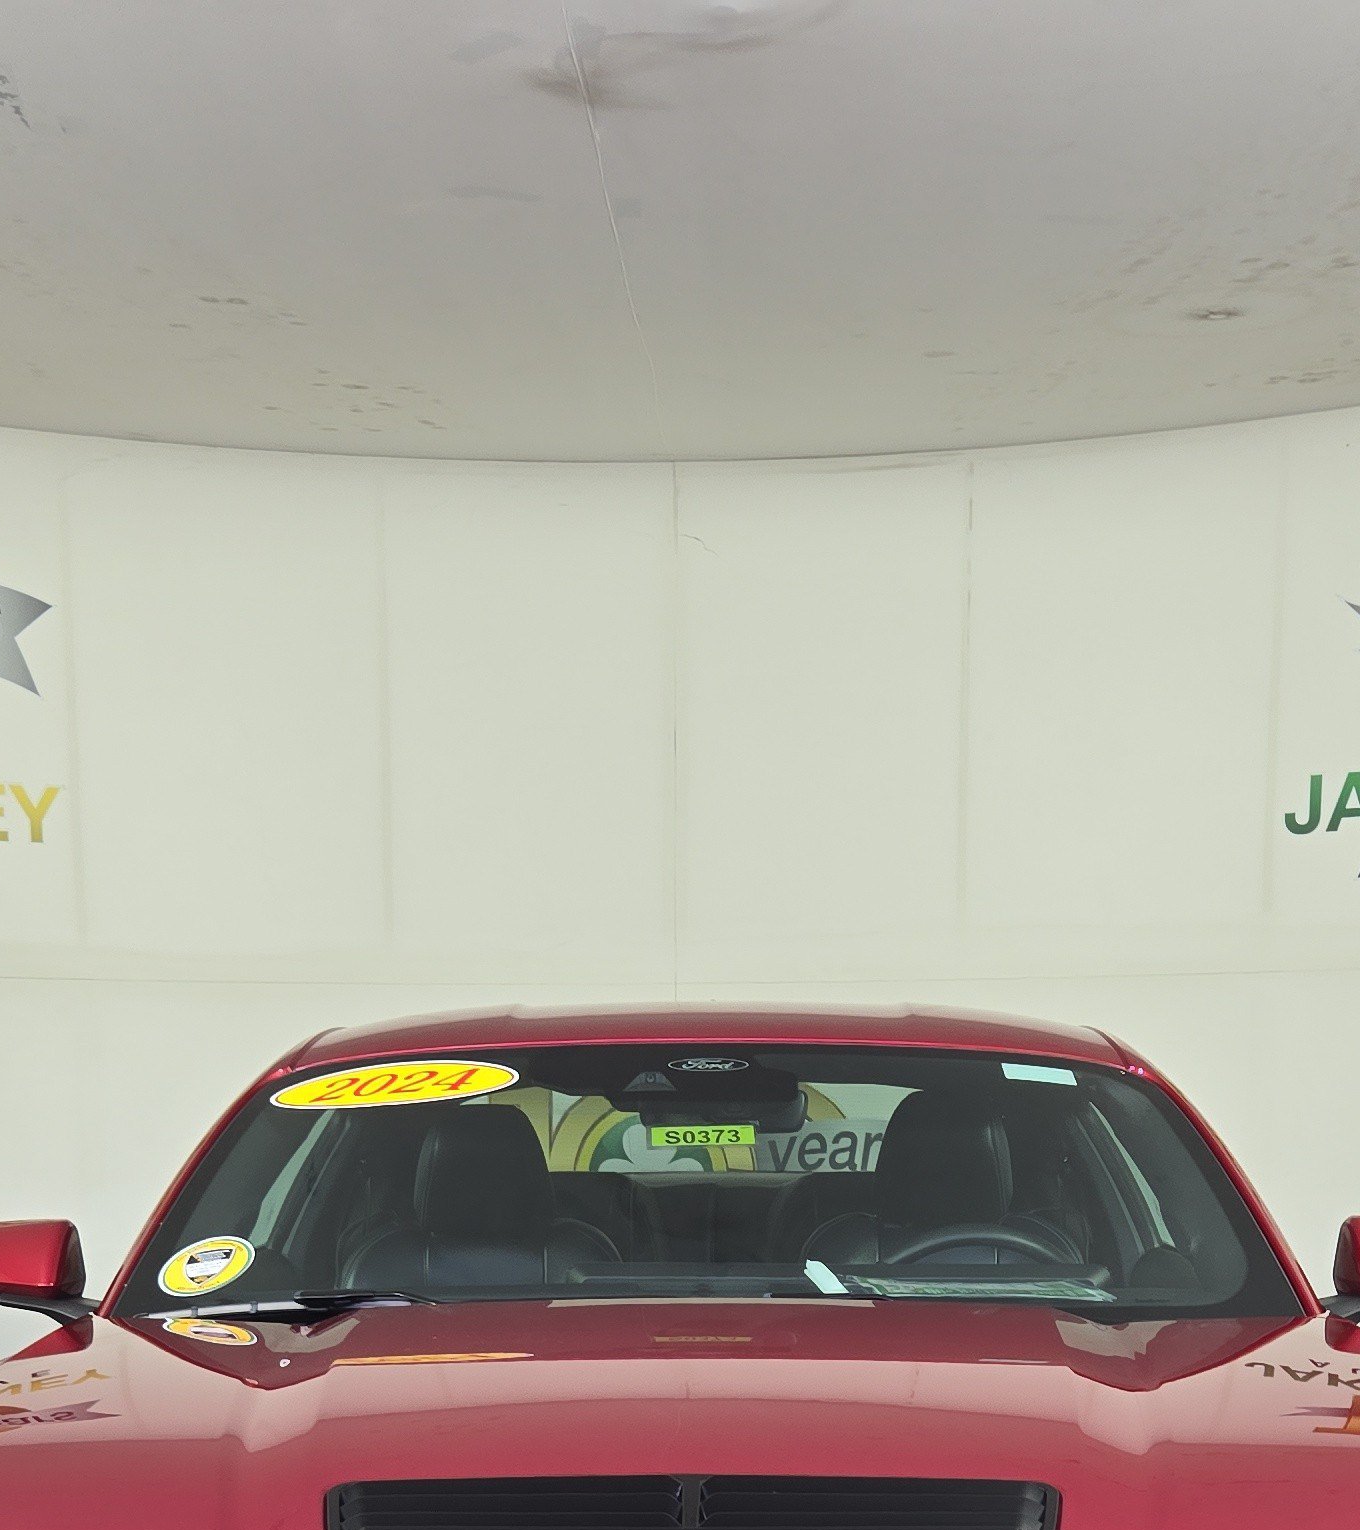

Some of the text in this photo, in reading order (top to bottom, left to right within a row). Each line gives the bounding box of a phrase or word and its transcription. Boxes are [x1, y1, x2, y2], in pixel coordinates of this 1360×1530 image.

[680, 1057, 737, 1071] Ford
[308, 1068, 480, 1104] 2024
[664, 1129, 742, 1145] S0373
[767, 1127, 884, 1173] year
